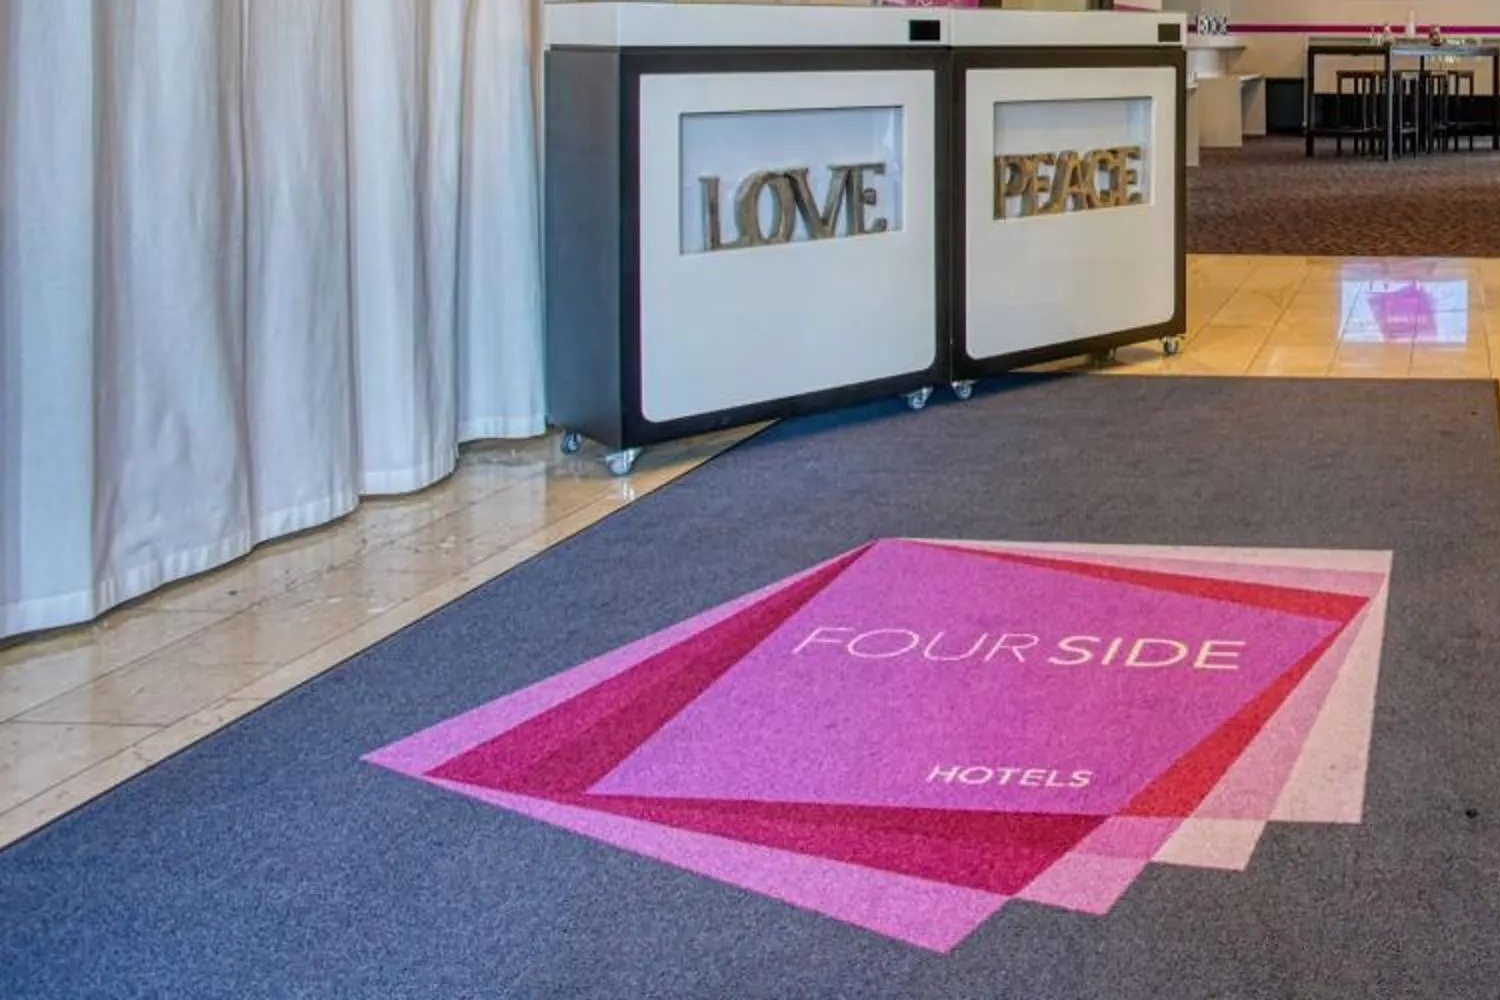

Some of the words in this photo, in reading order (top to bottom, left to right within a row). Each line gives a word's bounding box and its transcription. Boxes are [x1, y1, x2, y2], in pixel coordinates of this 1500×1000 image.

[698, 160, 888, 252] LOVE
[993, 145, 1146, 221] PEACE
[790, 626, 1041, 664] FOUR
[1048, 634, 1248, 671] SIDE
[925, 764, 1096, 789] HOTELS
